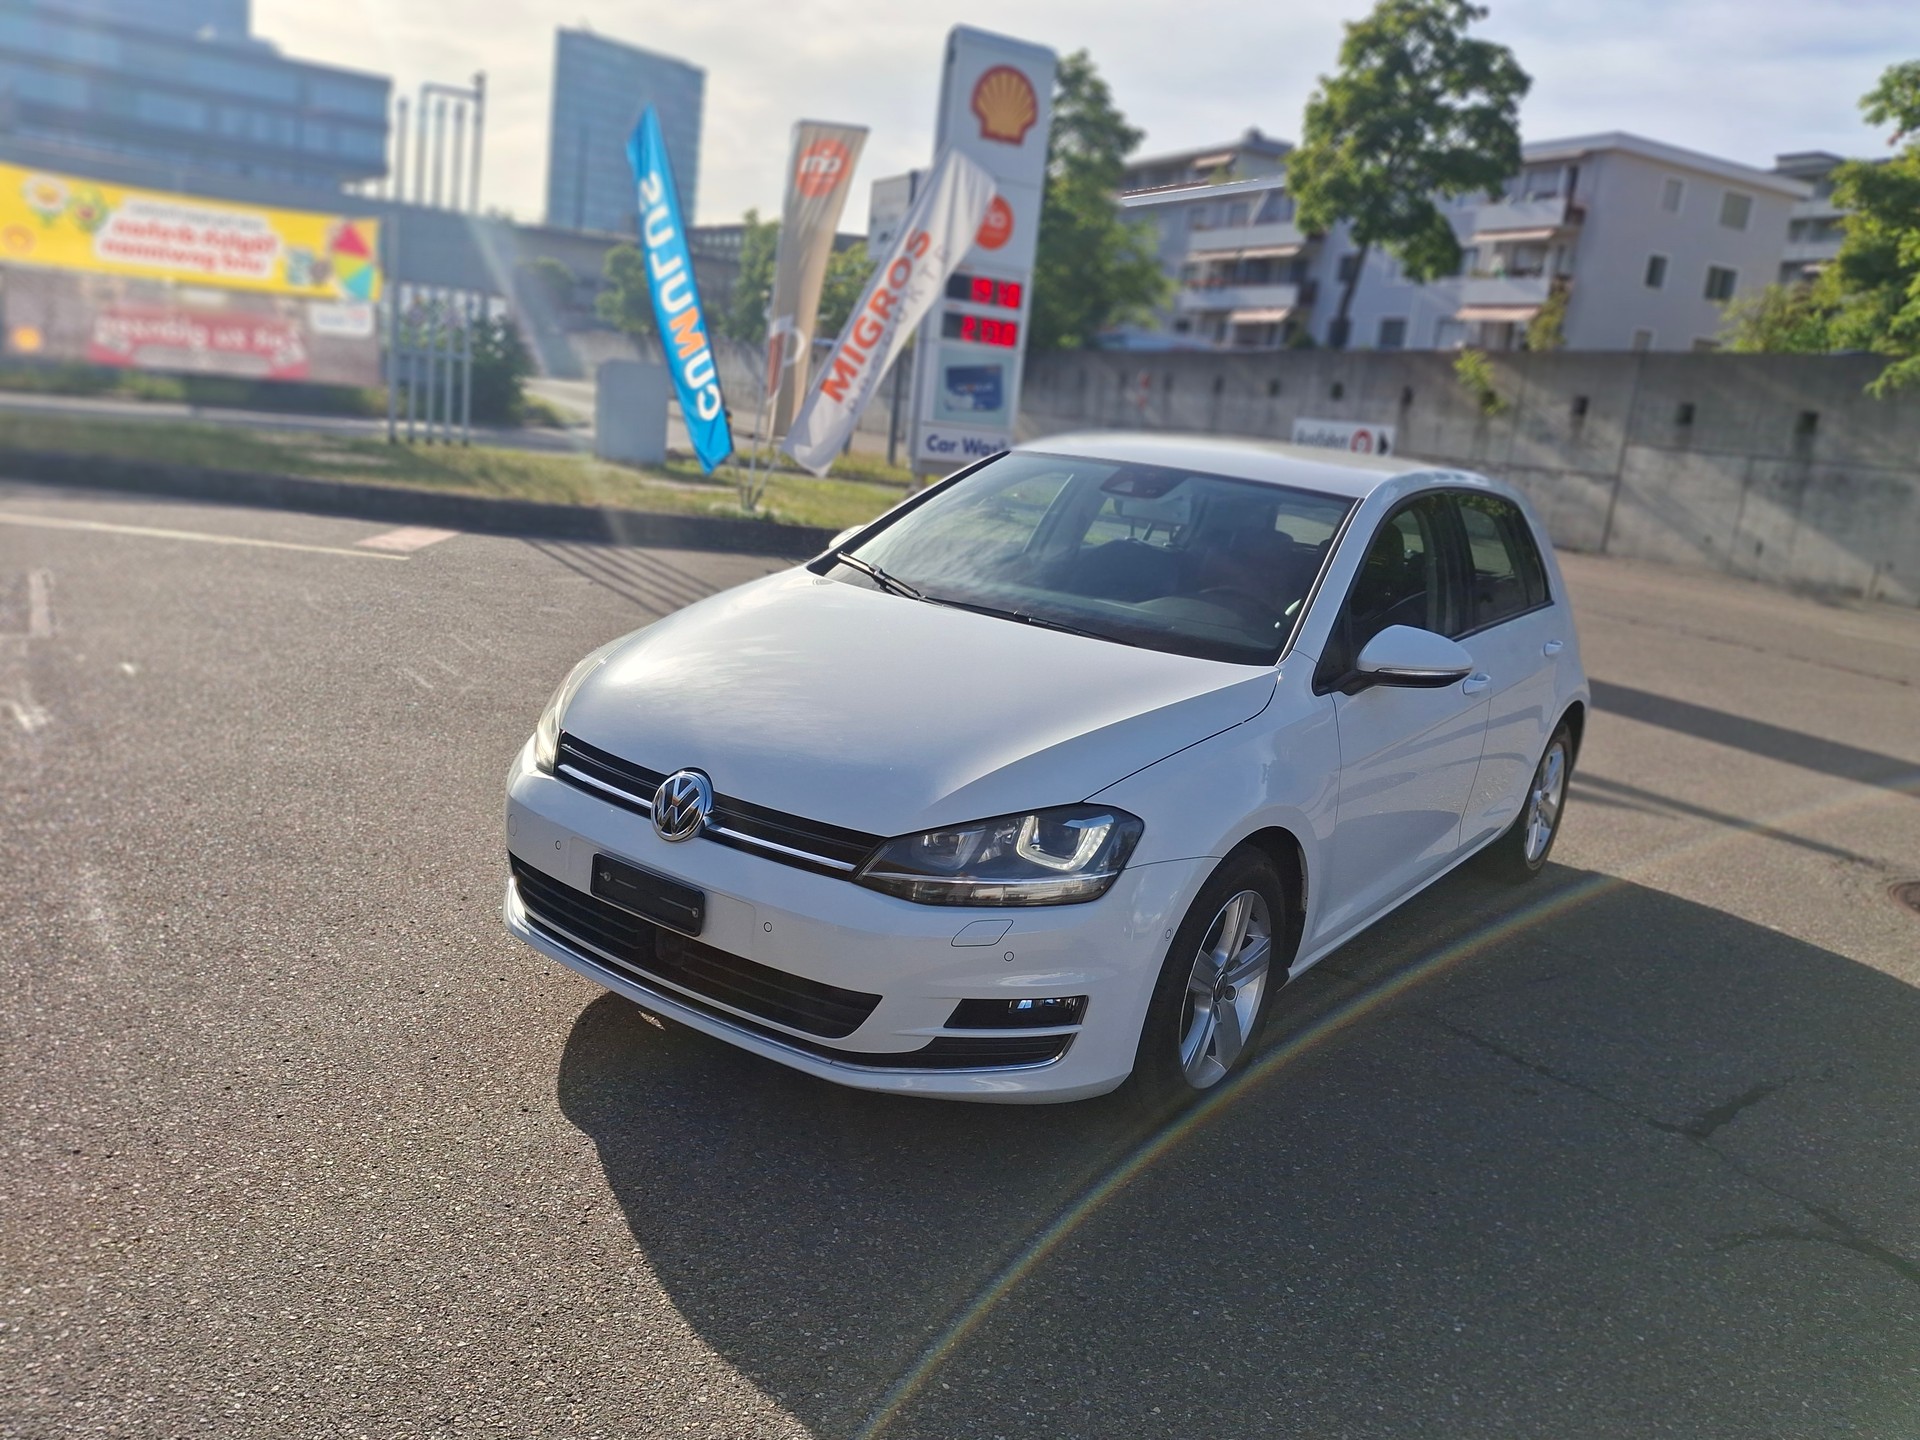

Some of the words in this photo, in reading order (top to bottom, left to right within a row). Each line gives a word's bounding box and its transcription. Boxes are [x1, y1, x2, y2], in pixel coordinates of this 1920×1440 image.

[820, 227, 931, 404] MIGROS
[926, 433, 957, 453] Car
[655, 774, 703, 838] VW
